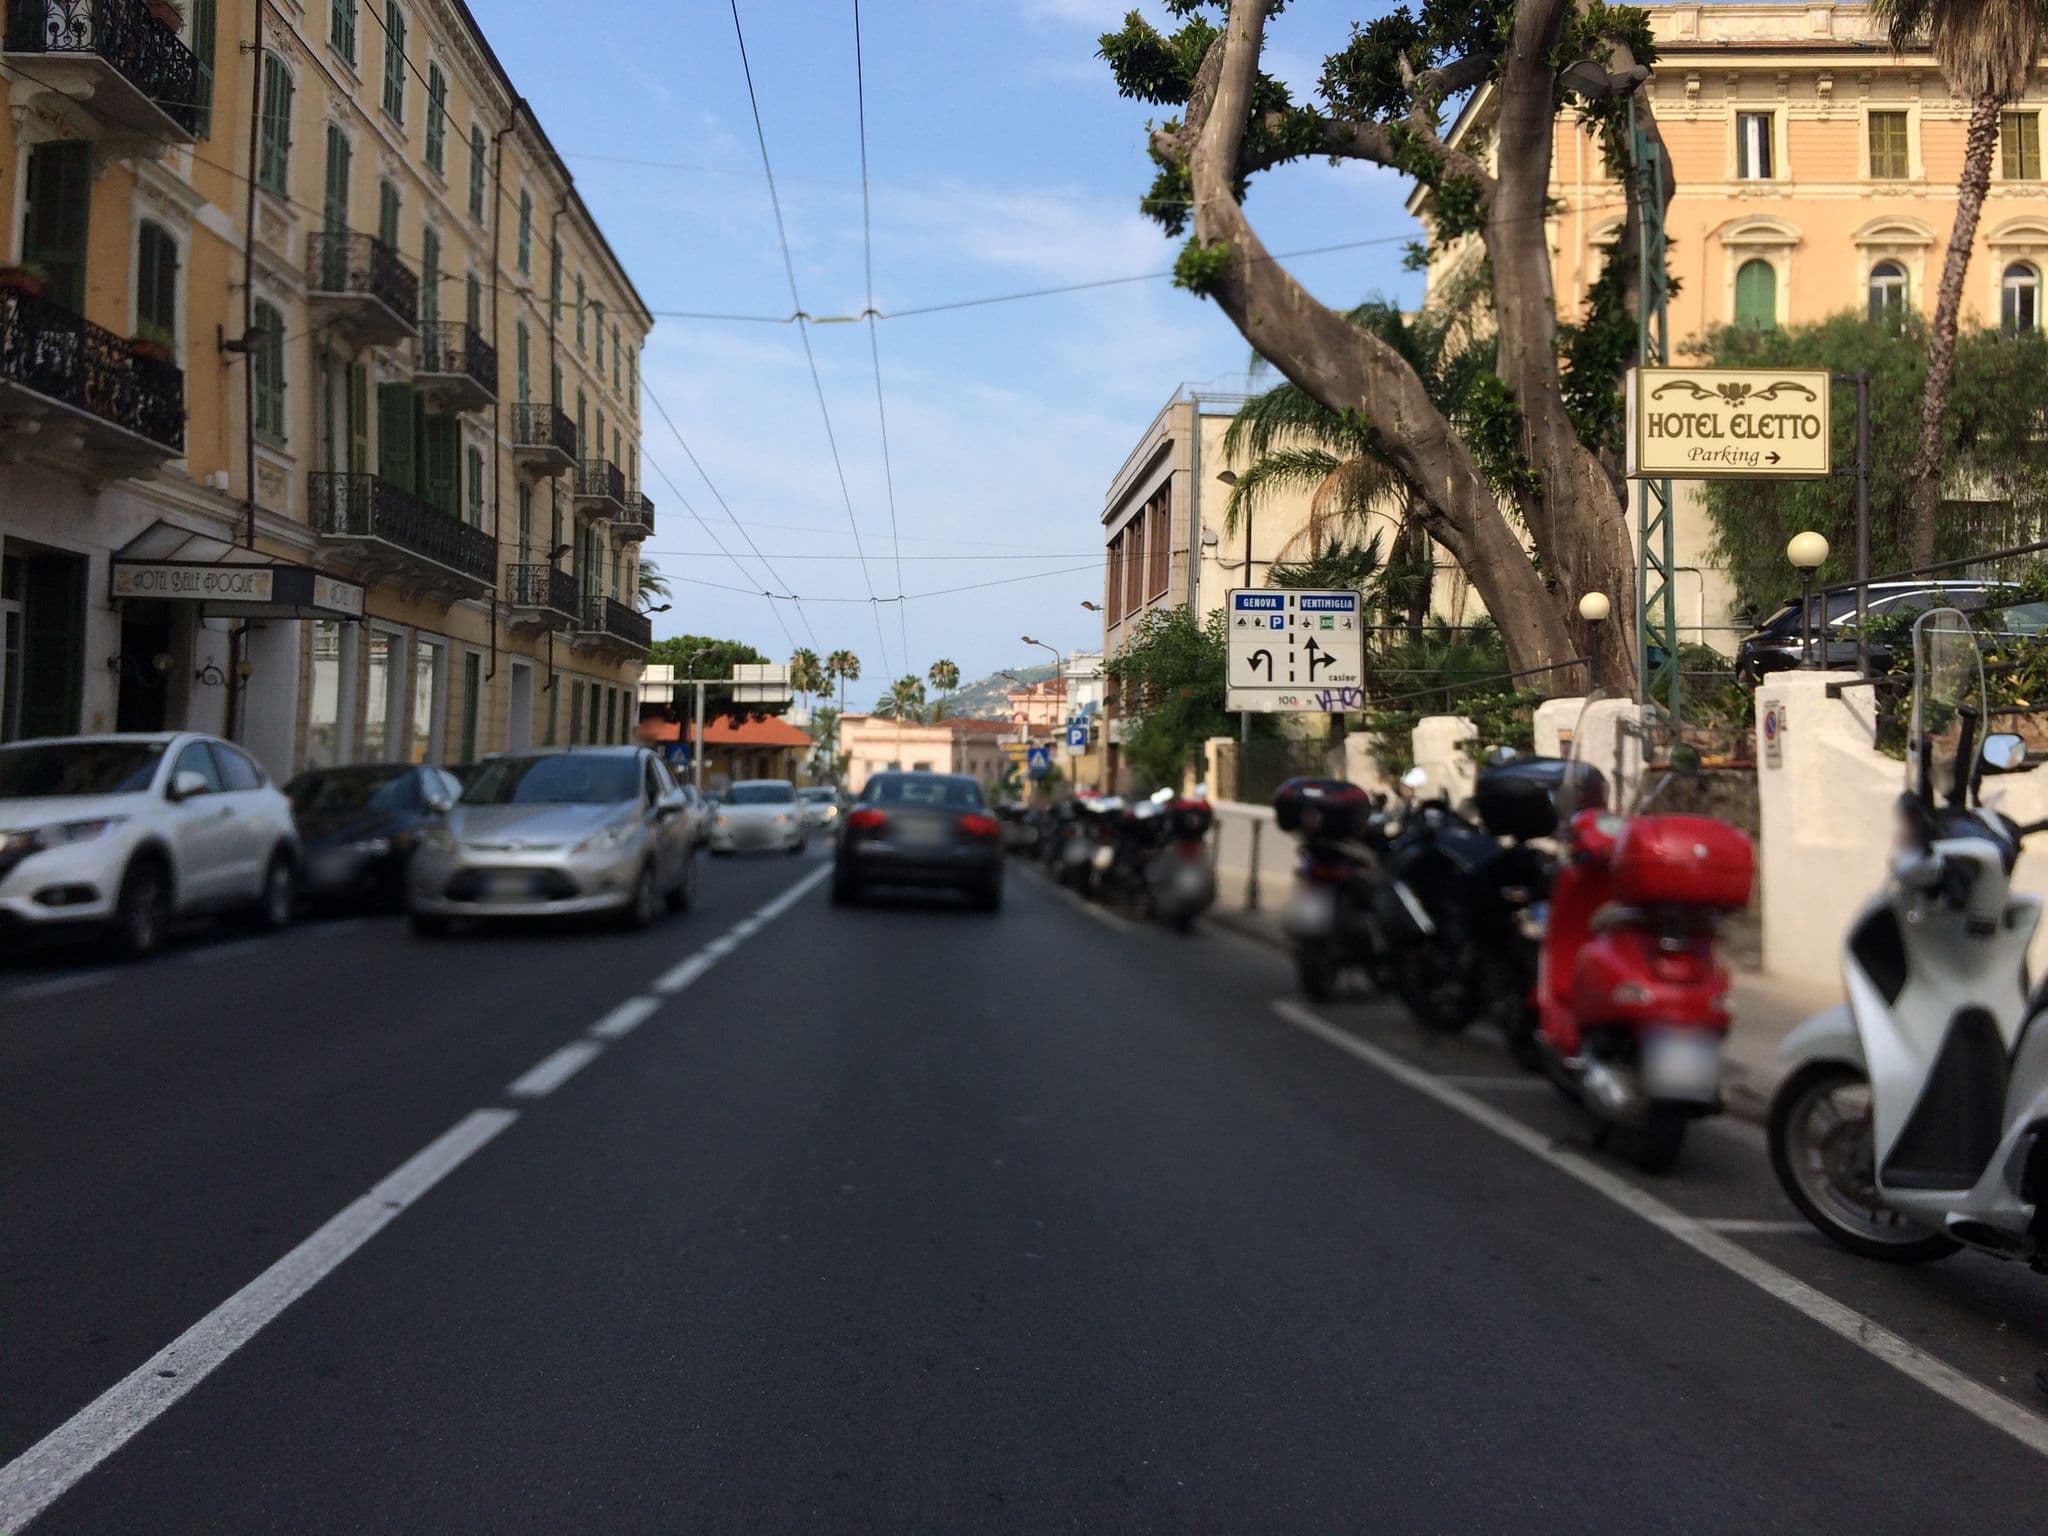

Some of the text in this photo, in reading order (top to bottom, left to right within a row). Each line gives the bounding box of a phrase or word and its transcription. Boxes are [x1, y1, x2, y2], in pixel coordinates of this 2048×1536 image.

[1648, 413, 1821, 440] HOTEL ELETTO
[1687, 444, 1760, 467] Parking
[1243, 598, 1276, 608] GENOVA
[1301, 599, 1353, 609] VENTIMIGLIA
[1272, 617, 1282, 628] P
[1328, 674, 1356, 682] casino
[1071, 729, 1082, 745] P
